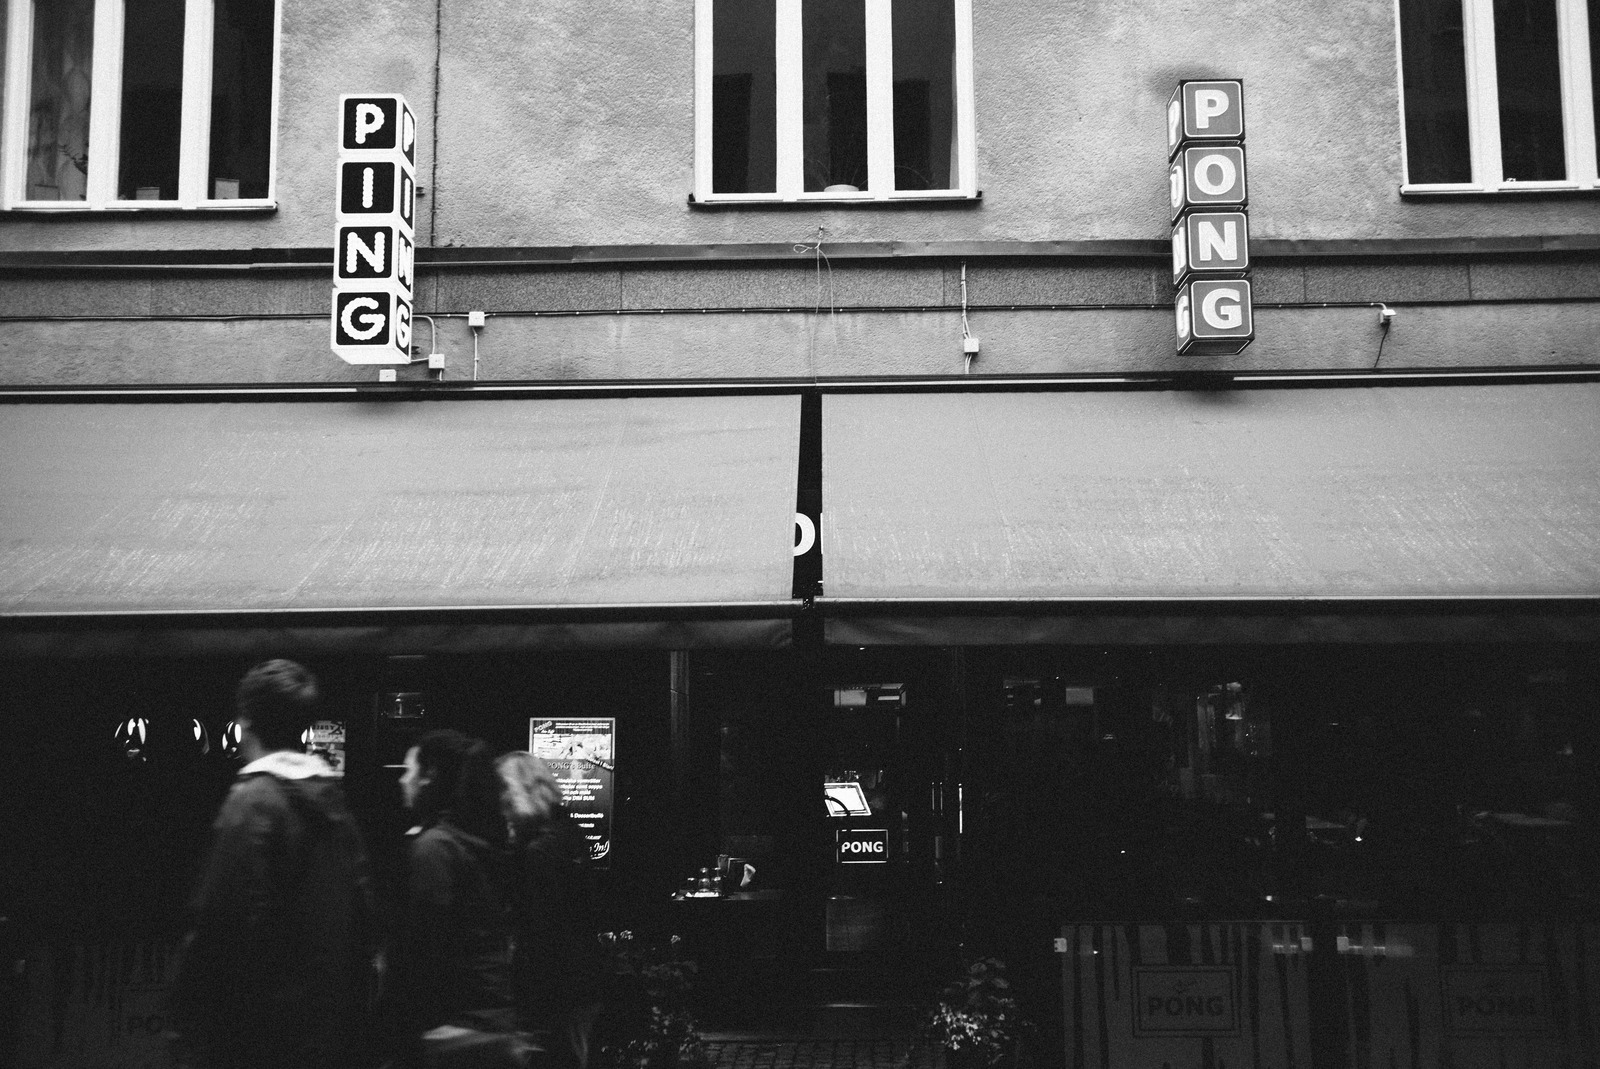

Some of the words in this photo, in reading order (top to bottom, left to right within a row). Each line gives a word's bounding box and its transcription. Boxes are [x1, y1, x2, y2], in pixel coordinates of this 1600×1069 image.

[340, 102, 386, 341] PING
[396, 111, 414, 349] PING
[1194, 89, 1243, 330] PONG
[841, 841, 884, 853] PONG
[1148, 996, 1224, 1017] PONG
